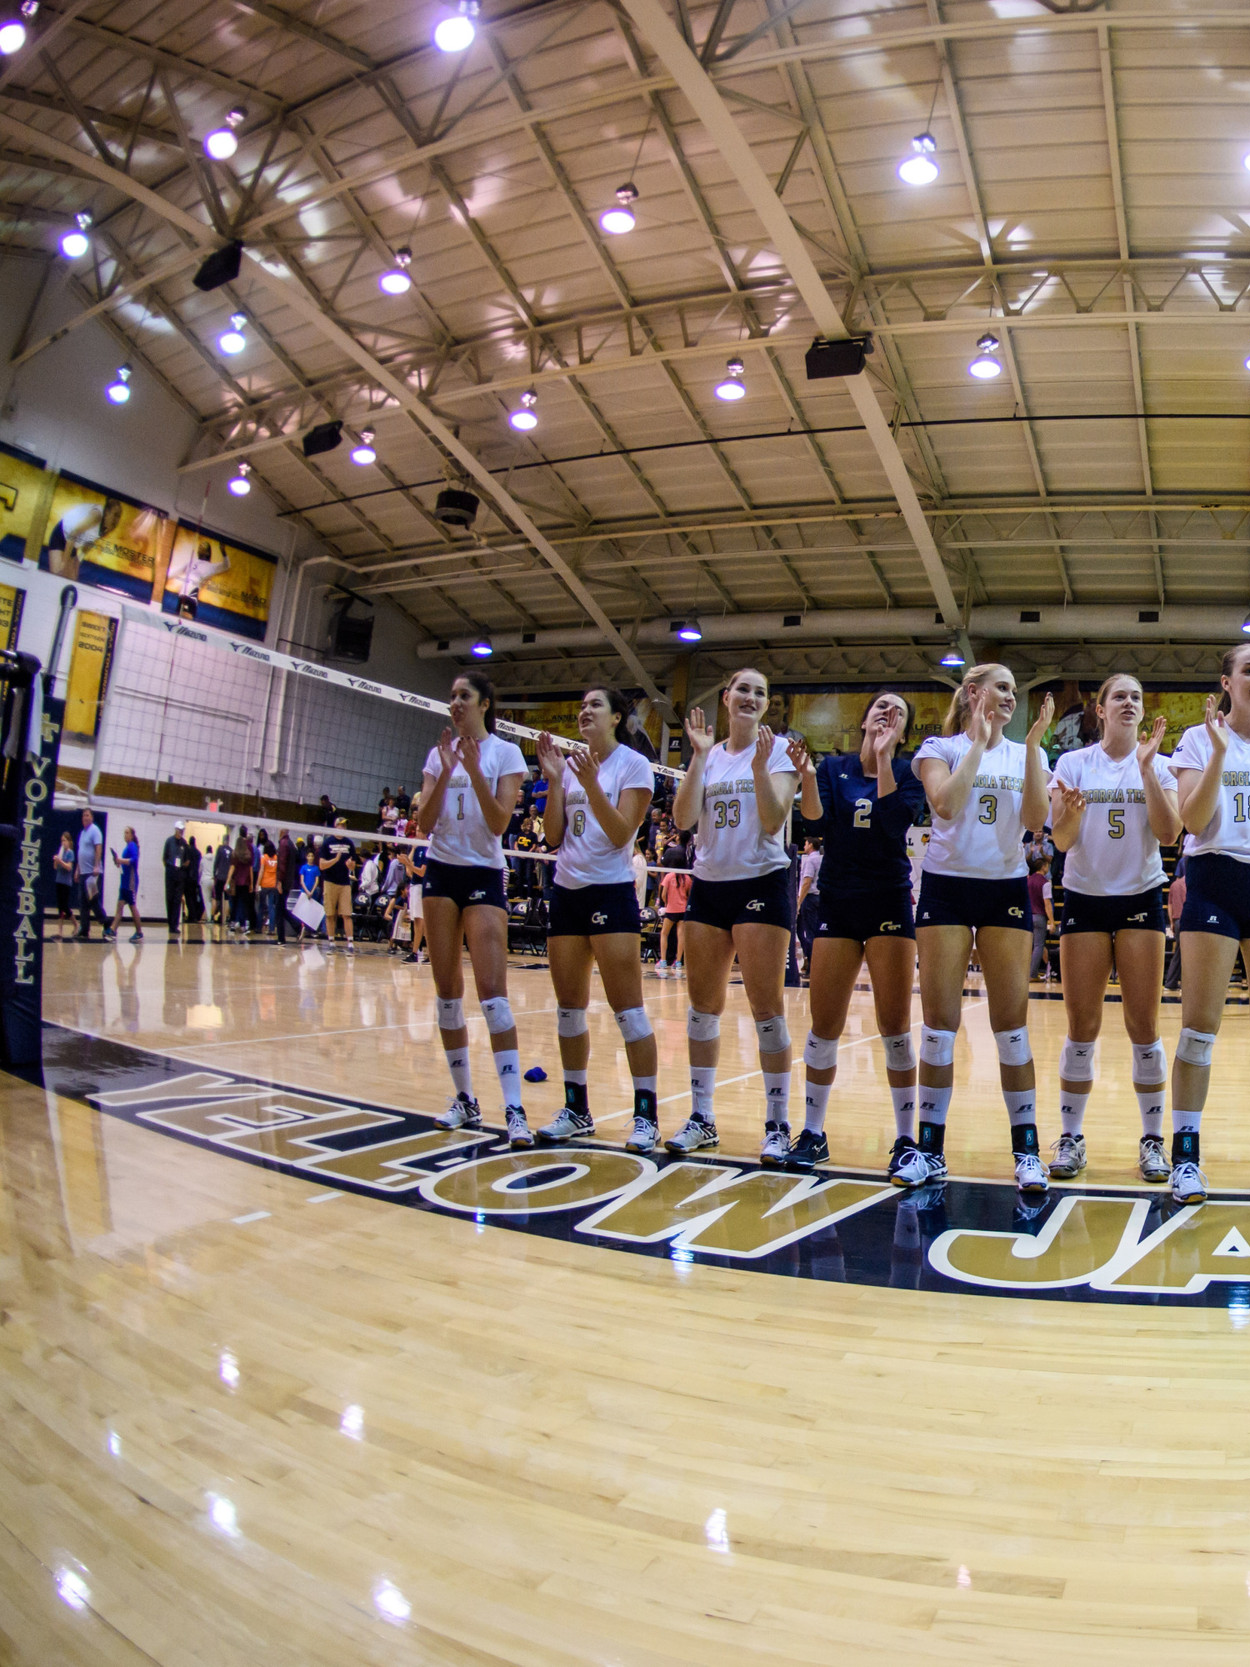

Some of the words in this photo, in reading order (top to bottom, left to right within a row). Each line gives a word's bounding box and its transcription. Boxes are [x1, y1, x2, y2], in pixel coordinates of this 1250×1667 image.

[78, 641, 105, 653] 2004
[457, 793, 465, 820] 1
[979, 795, 998, 824] 3
[1126, 788, 1146, 804] TEC
[573, 810, 587, 837] 8
[713, 799, 741, 829] 33
[853, 798, 873, 829] 2
[1108, 809, 1125, 839] 5
[14, 756, 51, 985] VOLLEYBALL
[591, 912, 608, 925] GT
[1008, 907, 1024, 918] GT
[86, 1072, 906, 1258] YELLOW
